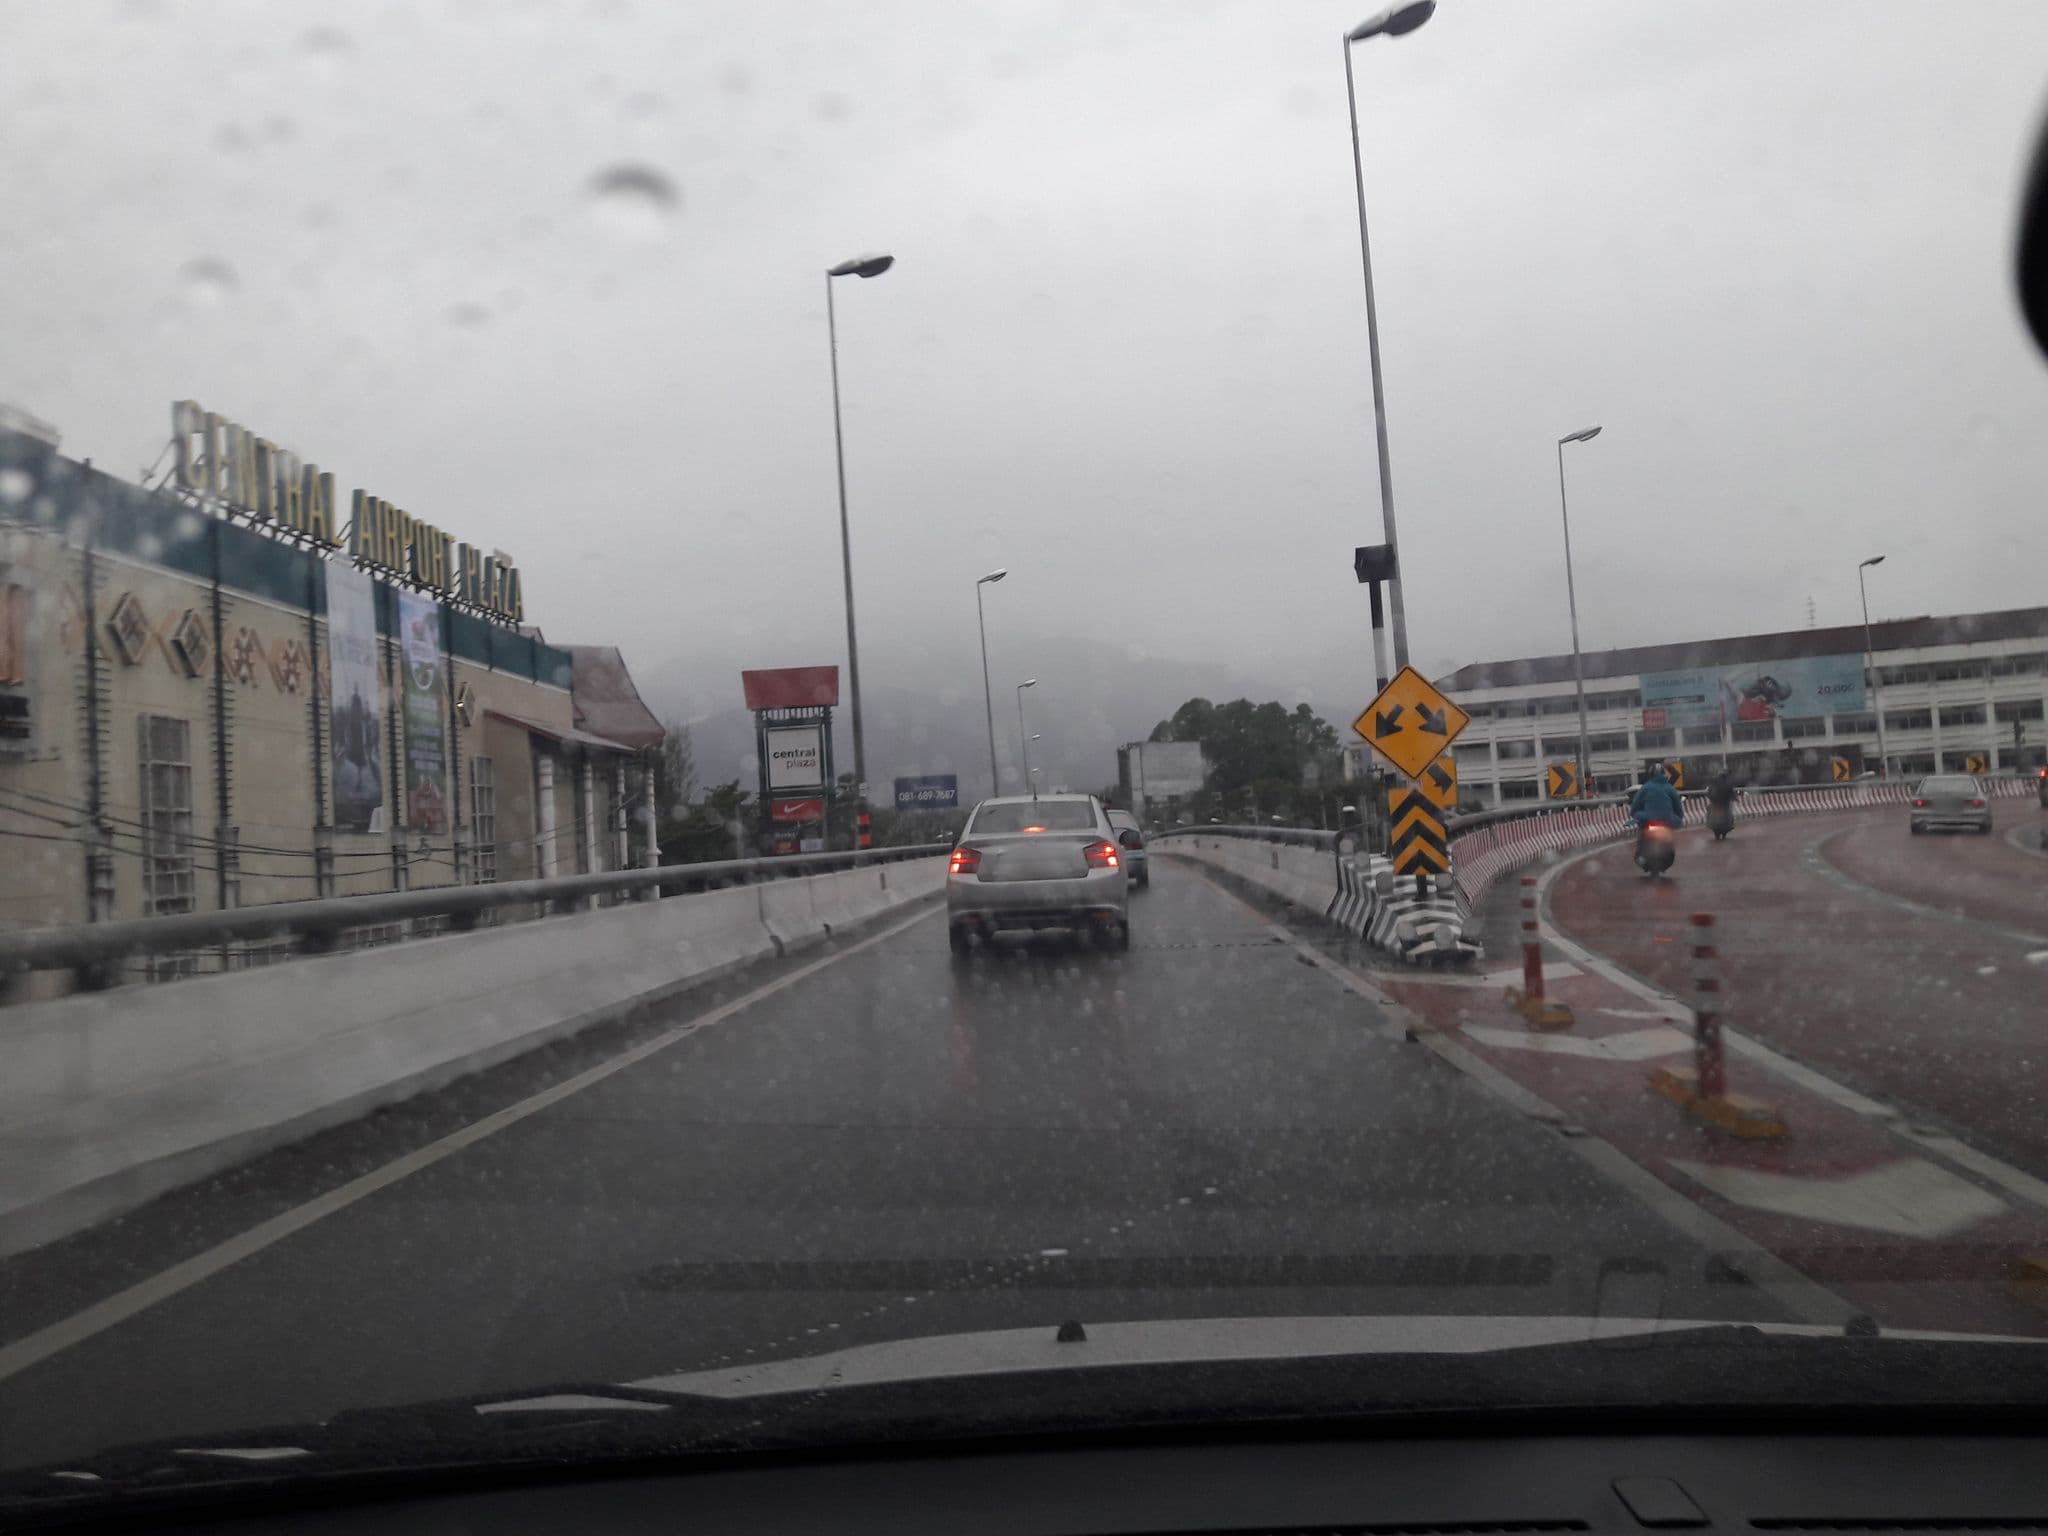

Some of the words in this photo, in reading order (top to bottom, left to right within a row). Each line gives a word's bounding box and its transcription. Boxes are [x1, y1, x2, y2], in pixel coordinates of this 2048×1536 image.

[172, 400, 343, 547] CENTRAL
[350, 488, 455, 595] AIRPORT
[457, 542, 523, 622] PLAZA
[773, 748, 816, 759] central
[786, 758, 816, 770] plaza
